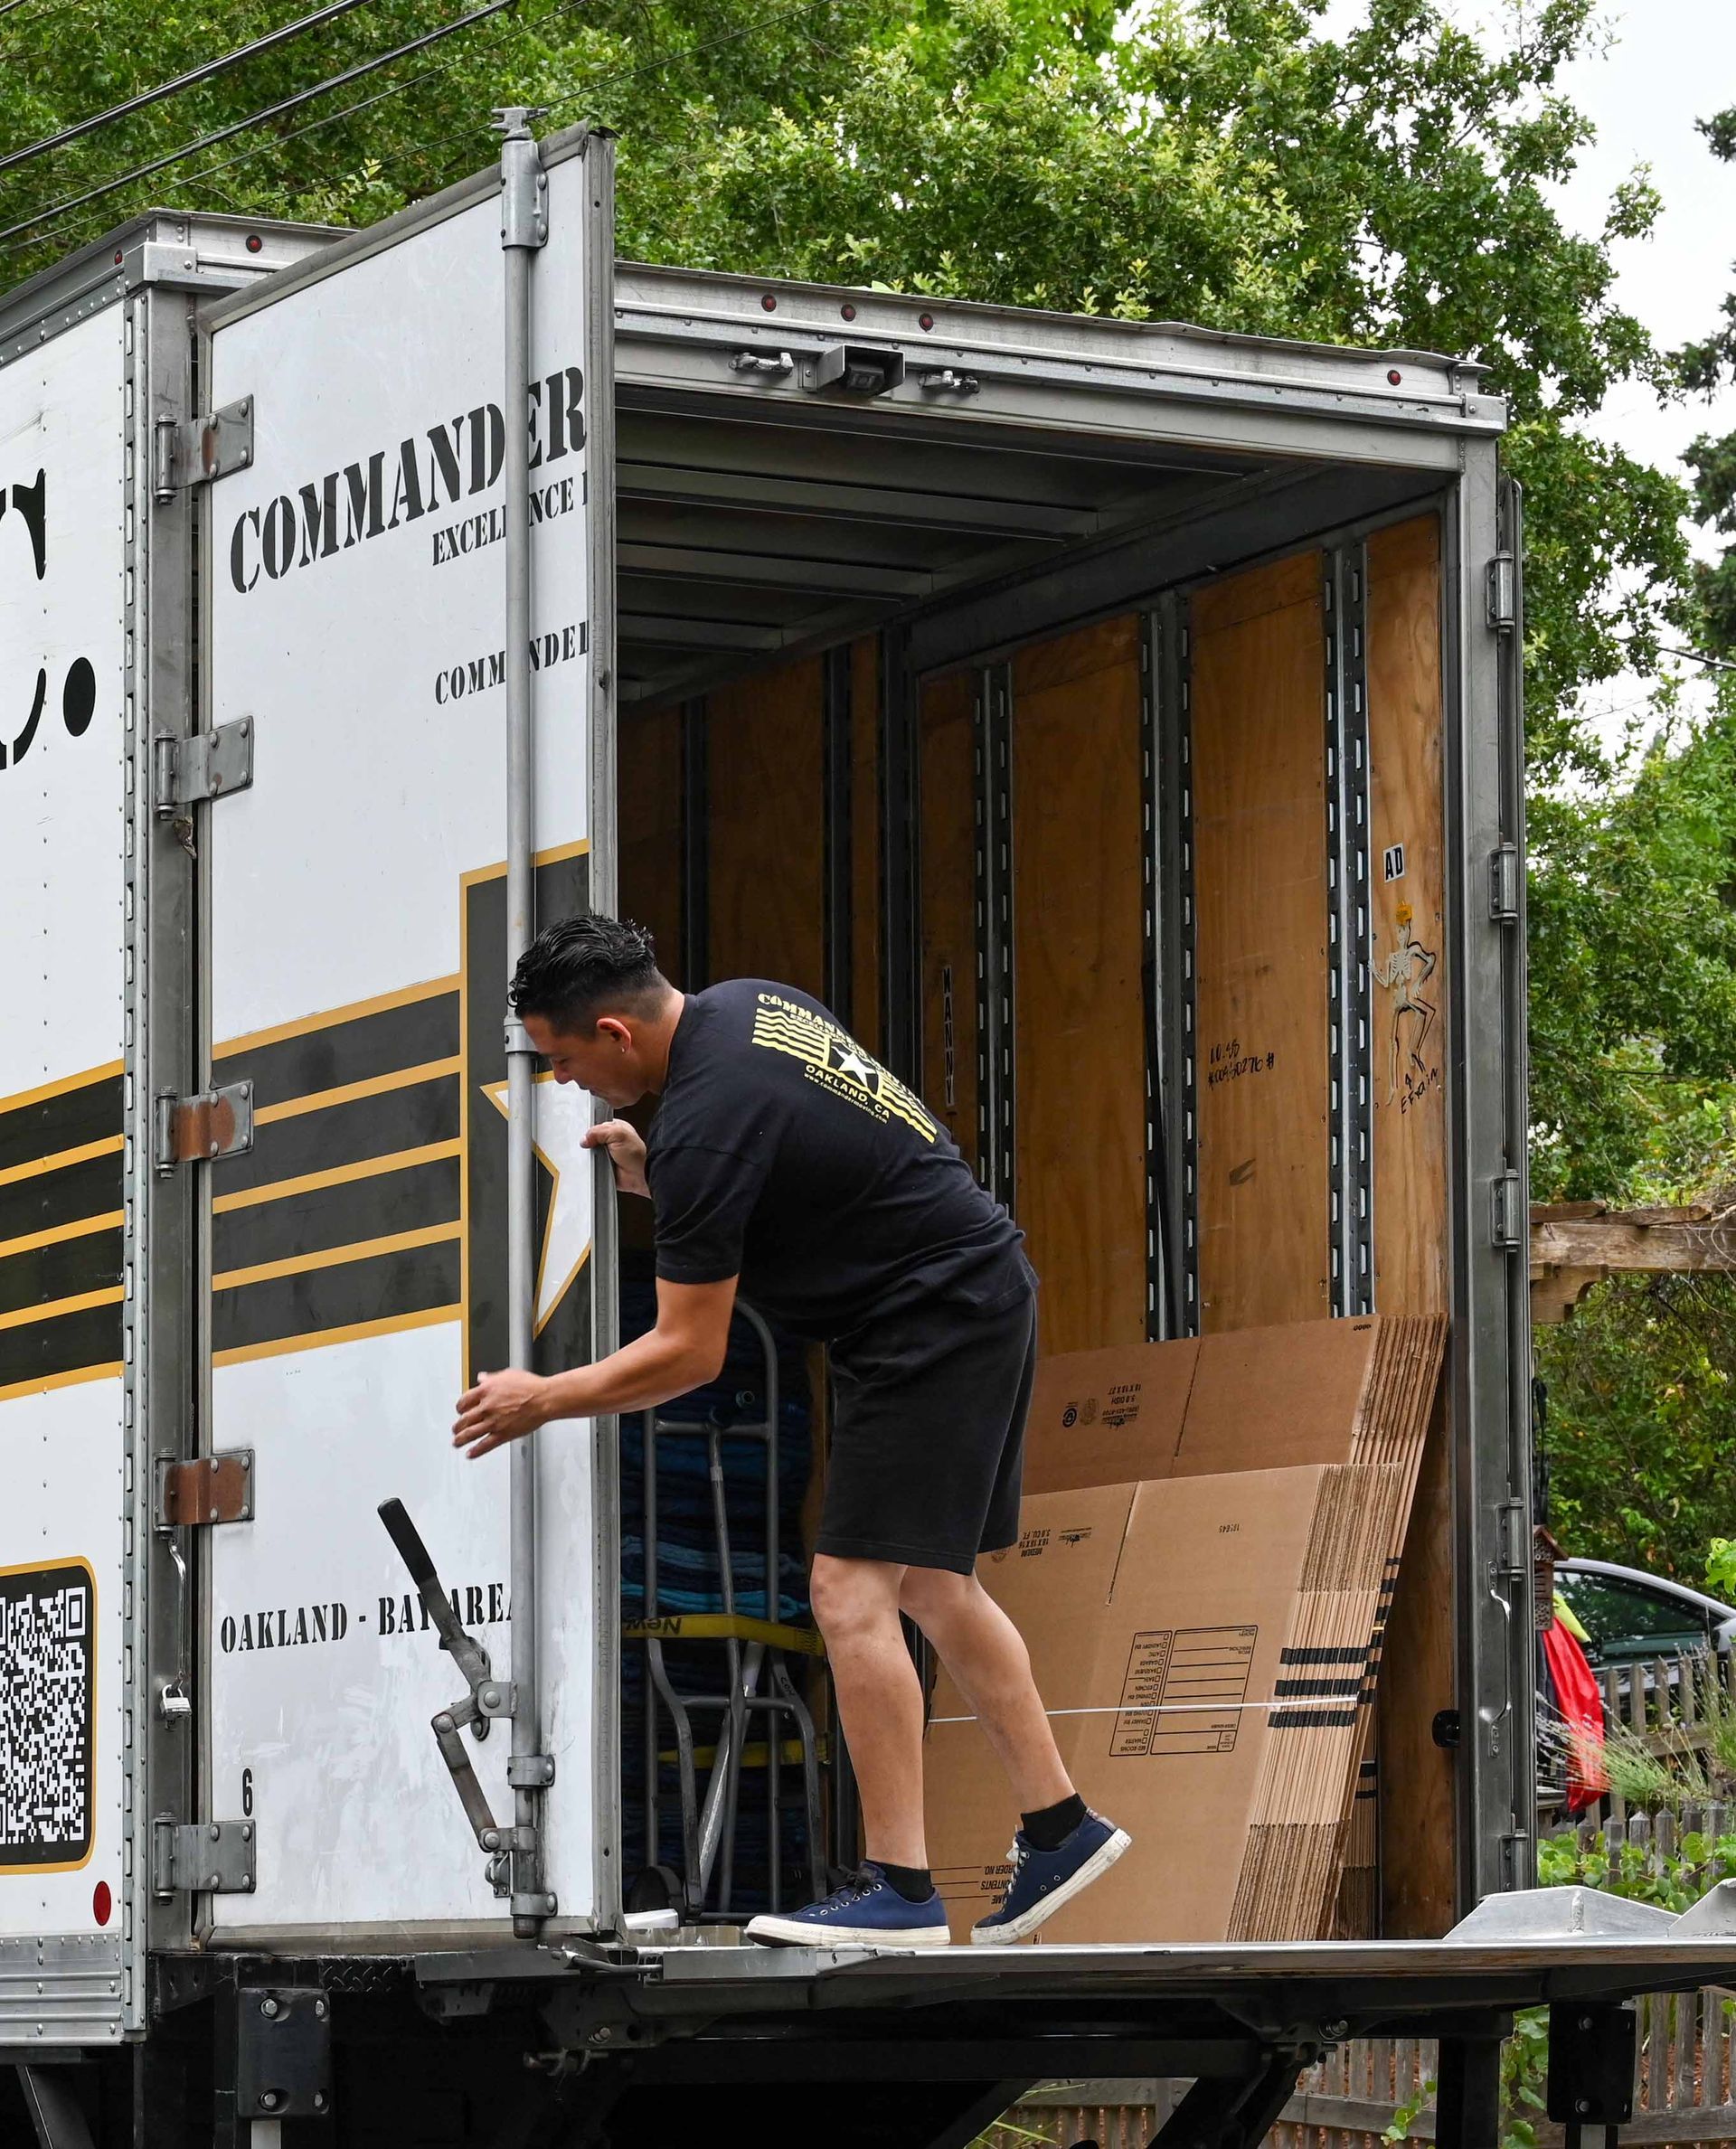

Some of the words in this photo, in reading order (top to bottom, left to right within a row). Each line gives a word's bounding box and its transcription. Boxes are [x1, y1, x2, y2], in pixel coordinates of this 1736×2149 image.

[432, 476, 574, 566] EXCELNCE
[1384, 846, 1404, 881] AD
[873, 1103, 890, 1119] CA
[220, 1603, 347, 1653] OAKLAND
[448, 1583, 512, 1626] ARE
[241, 1767, 253, 1817] 6
[980, 1880, 1012, 1890] ONTENTS
[996, 1864, 1016, 1875] RDER
